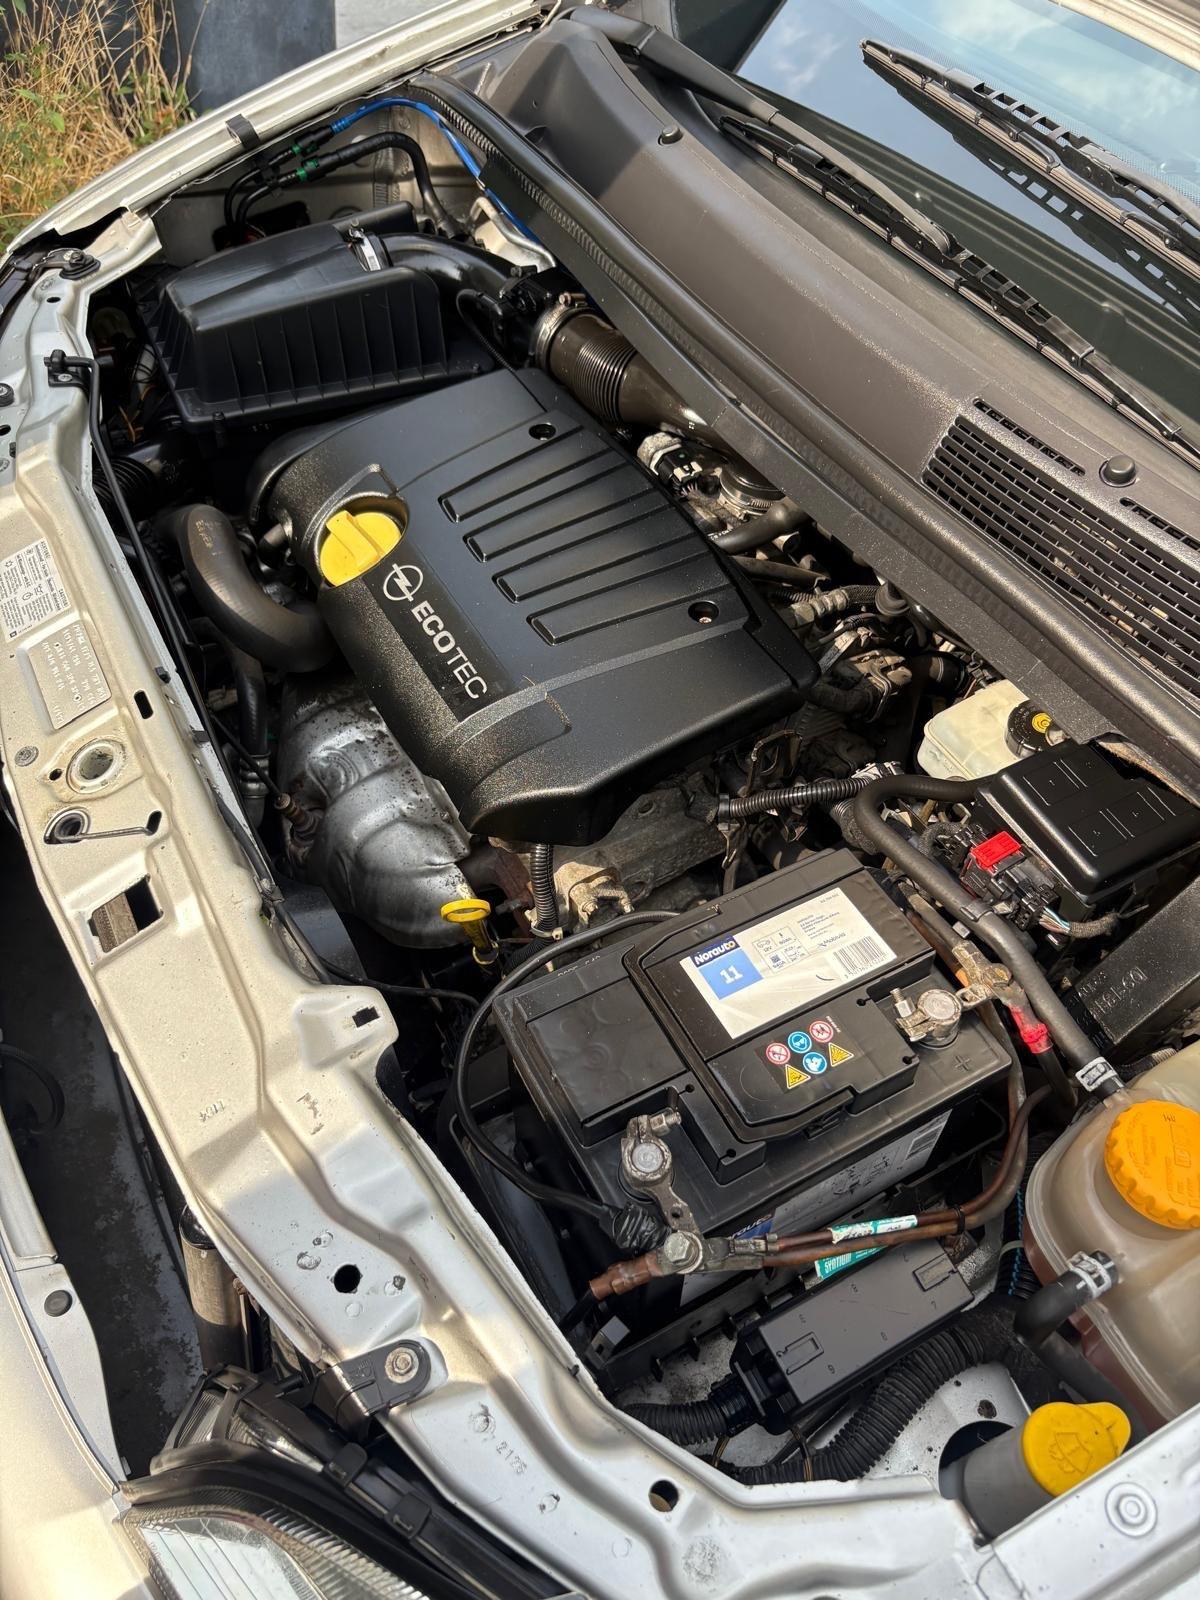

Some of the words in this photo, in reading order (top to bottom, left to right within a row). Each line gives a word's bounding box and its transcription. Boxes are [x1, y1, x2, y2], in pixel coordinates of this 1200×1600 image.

[411, 600, 488, 699] ECOTEC
[694, 940, 736, 965] Norauto
[720, 965, 744, 985] 11
